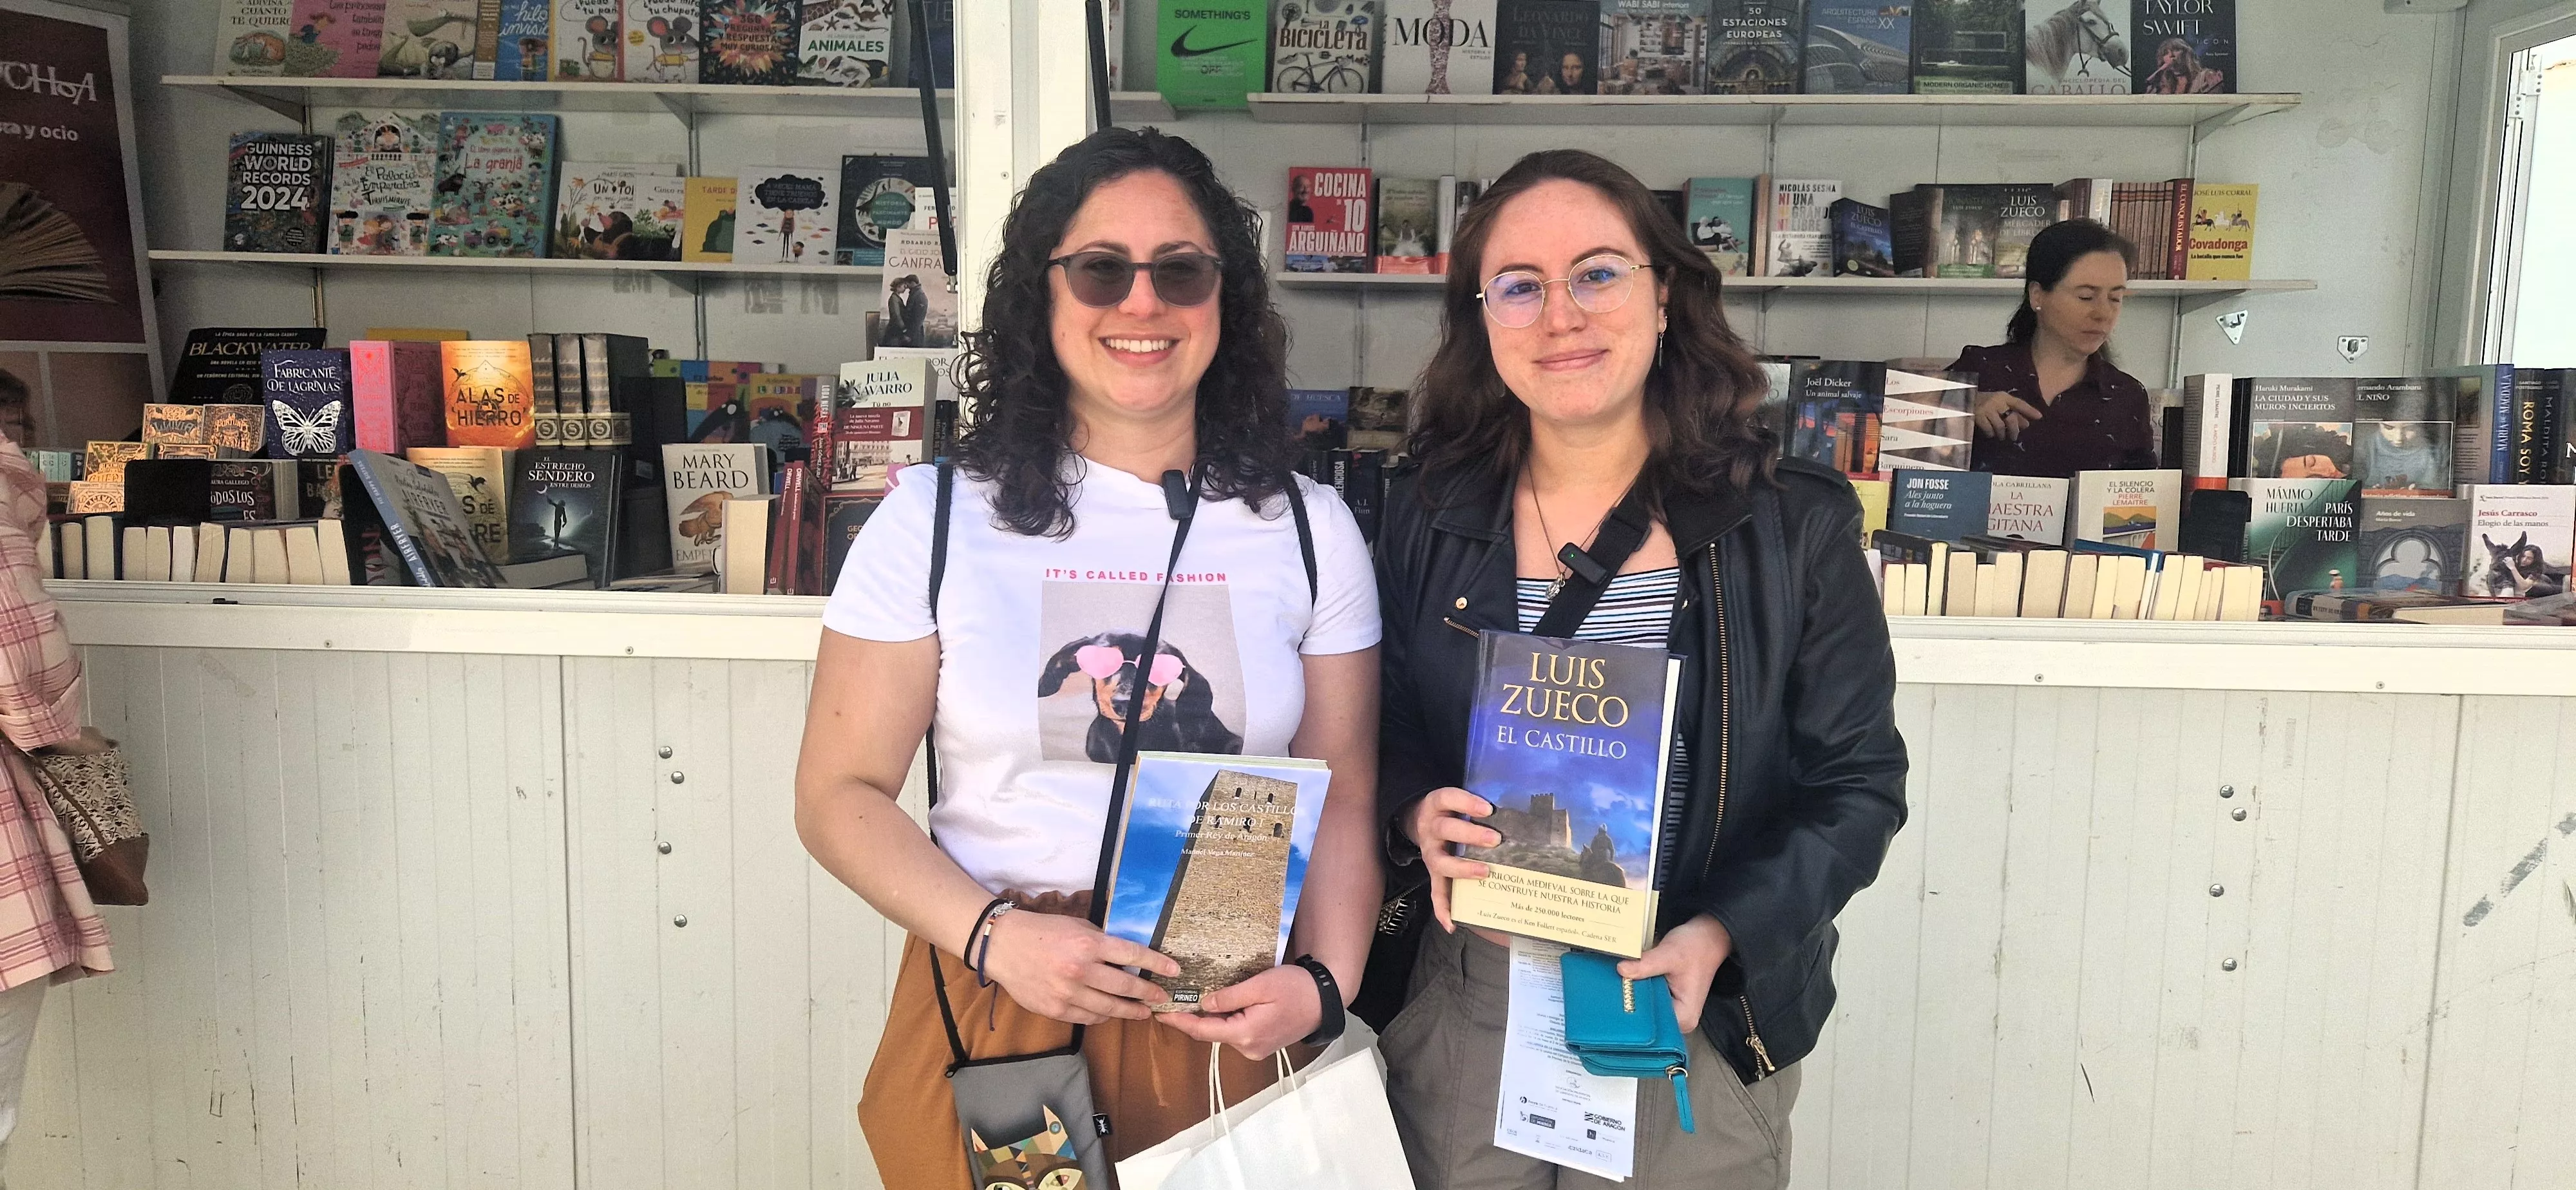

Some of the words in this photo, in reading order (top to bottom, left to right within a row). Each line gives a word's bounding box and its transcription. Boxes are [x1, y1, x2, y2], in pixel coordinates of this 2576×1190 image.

[1822, 7, 1877, 16] ARQUITECTURA
[2145, 0, 2213, 14] TAYLOR
[232, 17, 245, 25] TE
[1175, 10, 1251, 20] SOMETHING'S
[1723, 18, 1787, 26] ESTACIONES
[1320, 20, 1330, 30] LA
[1878, 17, 1895, 30] XX
[2143, 19, 2203, 35] SWIFT
[1279, 28, 1368, 51] BICICLETA
[1394, 17, 1491, 48] MODA
[808, 39, 884, 53] ANIMALES
[40, 125, 79, 141] ocio
[247, 143, 312, 156] GUINNESS
[244, 155, 312, 171] WORLD
[465, 153, 480, 169] La
[486, 156, 523, 175] granja
[242, 172, 310, 185] RECORDS
[1314, 172, 1366, 198] COCINA
[594, 184, 608, 193] UN
[1779, 182, 1810, 193] NICOLÁS
[241, 185, 310, 210] 2024
[1793, 193, 1814, 206] UNA
[2011, 194, 2037, 206] LUIS
[2000, 206, 2045, 218] ZUECO
[1851, 212, 1882, 227] ZUECO
[2003, 219, 2051, 227] MERCADER
[2175, 194, 2188, 251] CONQUISTADOR
[1289, 229, 1365, 253] ARGUIÑANO
[2190, 238, 2248, 252] Covadonga
[189, 342, 311, 356] BLACKWATER
[273, 359, 336, 379] FABRICANTE
[267, 378, 285, 392] DE
[866, 371, 900, 385] JULIA
[1805, 377, 1822, 387] Joël
[1824, 377, 1852, 387] Dicker
[1886, 376, 1900, 386] Los
[456, 387, 504, 404] ALAS
[507, 393, 520, 404] DE
[853, 382, 913, 396] NAVARRO
[2365, 393, 2391, 401] NIÑO
[1883, 404, 1934, 415] Escorpiones
[2288, 402, 2336, 411] INCIERTOS
[457, 410, 522, 426] HIERRO
[2521, 401, 2535, 444] ROMA
[2541, 397, 2553, 457] MALDITA
[535, 461, 585, 471] ESTRECHO
[683, 453, 735, 469] MARY
[2519, 448, 2532, 475] SOY
[528, 469, 594, 482] SENDERO
[674, 470, 749, 489] BEARD
[784, 468, 793, 489] ORWELL
[794, 468, 802, 492] ORWELL
[1906, 477, 1924, 489] JON
[1924, 478, 1949, 490] FOSSE
[236, 490, 255, 506] LOS
[1905, 490, 1921, 499] Ales
[1922, 491, 1944, 500] junto
[2011, 491, 2024, 500] LA
[2266, 486, 2313, 500] MÁXIMO
[1921, 500, 1953, 509] hoguera
[2265, 502, 2305, 513] HUERTA
[2324, 500, 2354, 514] PARÍS
[2286, 515, 2353, 528] DESPERTABA
[2477, 519, 2501, 528] Elogio
[390, 522, 418, 562] AIRFRYER
[2316, 529, 2352, 542] TARDE
[1046, 568, 1077, 579] IT'S
[1086, 570, 1149, 581] CALLED
[1530, 652, 1605, 689] LUIS
[1500, 683, 1629, 728] ZUECO
[1497, 725, 1518, 744] EL
[1525, 730, 1627, 759] CASTILLO
[1213, 802, 1236, 812] LOS
[1190, 815, 1204, 825] DE
[1208, 816, 1257, 827] RAMIRO
[1175, 829, 1204, 839] Primer
[1206, 831, 1223, 841] Rey
[1236, 832, 1268, 842] Aragón
[1180, 847, 1206, 856] Manuel
[1208, 848, 1225, 858] Vega
[1478, 880, 1486, 888] SE
[1488, 882, 1539, 898] CONSTRUYE
[1540, 891, 1579, 907] NUESTRA
[1581, 899, 1622, 914] HISTORIA
[1527, 878, 1567, 893] MEDIEVAL
[1570, 886, 1596, 898] SOBRE
[1598, 892, 1609, 902] LA
[1611, 894, 1630, 906] QUE
[1510, 902, 1524, 911] Más
[1534, 906, 1560, 917] 250.000
[1561, 912, 1585, 922] lectores
[1493, 912, 1510, 921] Zueco
[1537, 921, 1555, 931] Follett
[1581, 930, 1603, 940] Cadena
[1604, 934, 1618, 943] SER
[1173, 994, 1198, 1003] PIRINEO
[1594, 1113, 1622, 1126] GOBIERNO
